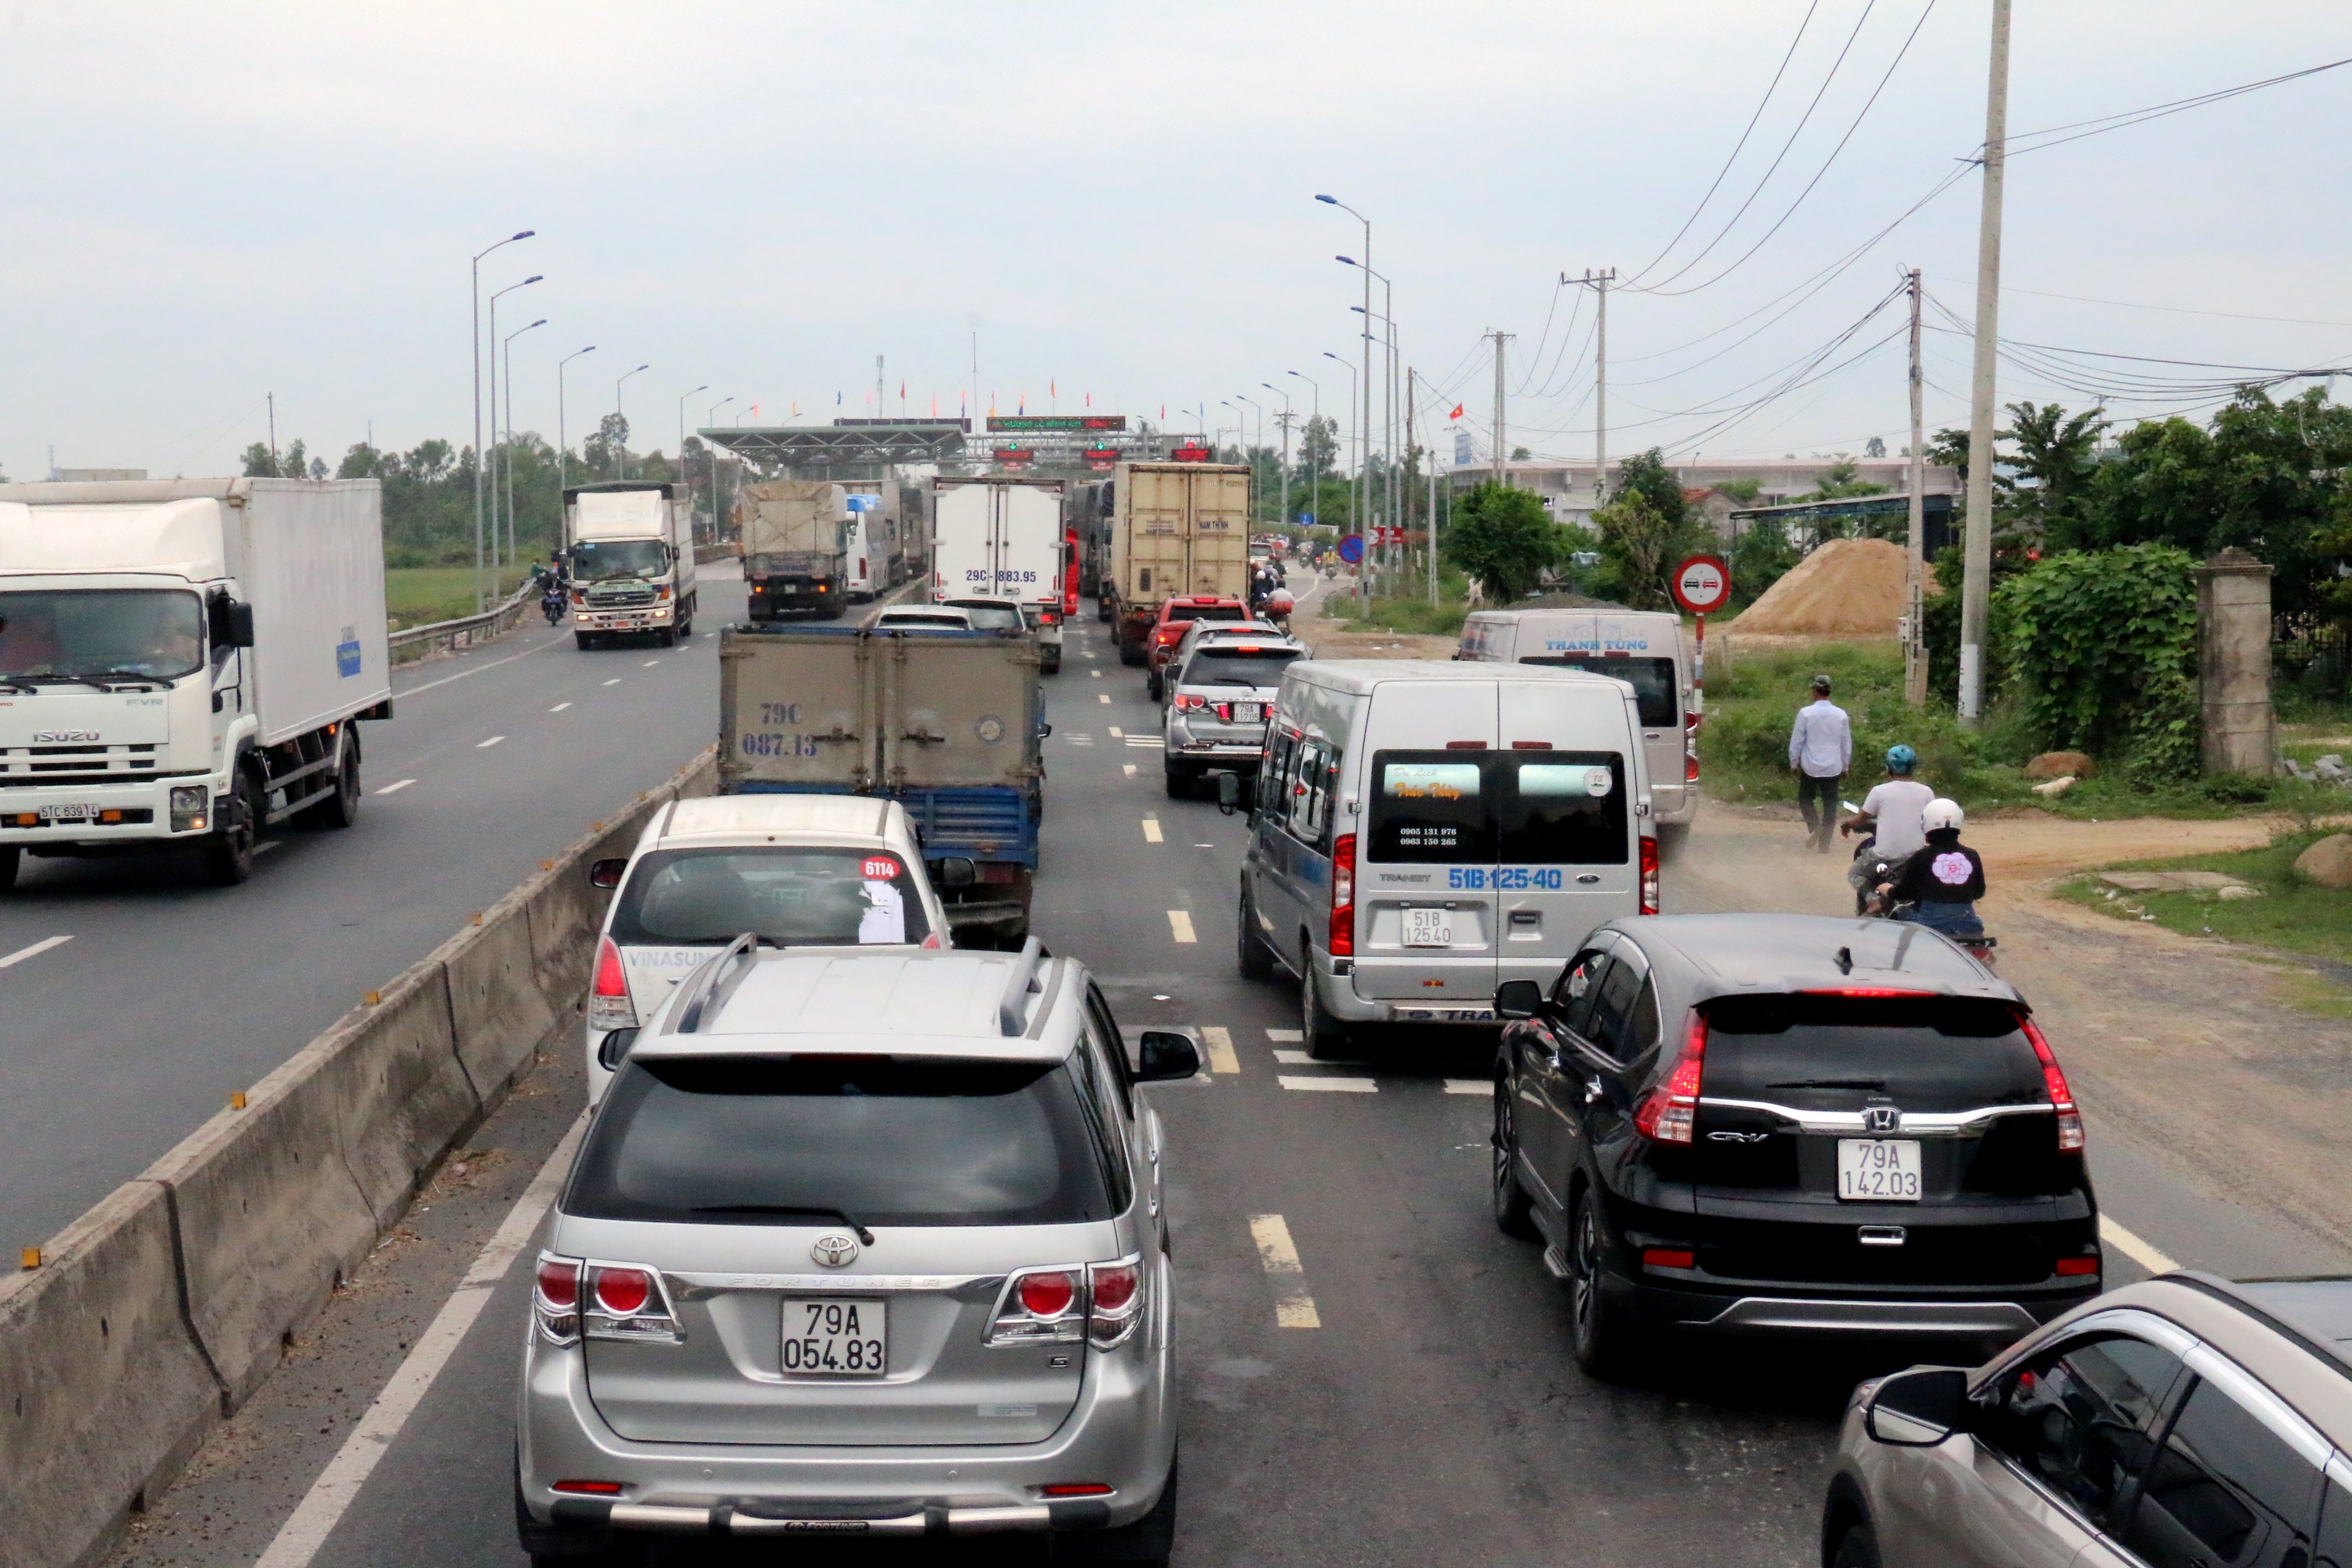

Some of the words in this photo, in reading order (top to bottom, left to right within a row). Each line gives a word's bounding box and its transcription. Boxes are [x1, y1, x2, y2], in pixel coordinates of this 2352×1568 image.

[1212, 520, 1229, 529] THNH
[761, 702, 801, 725] 79C
[34, 729, 99, 742] ISUZU
[865, 861, 895, 877] 6114
[1379, 874, 1431, 882] TRANSIT
[1415, 912, 1440, 926] 51B
[1406, 927, 1451, 943] 125.40
[1707, 1132, 1769, 1142] CR-V
[1859, 1144, 1901, 1169] 79A
[1845, 1171, 1918, 1197] 142.03
[727, 1277, 941, 1288] FORTUNER
[806, 1304, 861, 1335] 79A
[784, 1339, 883, 1371] 054.83
